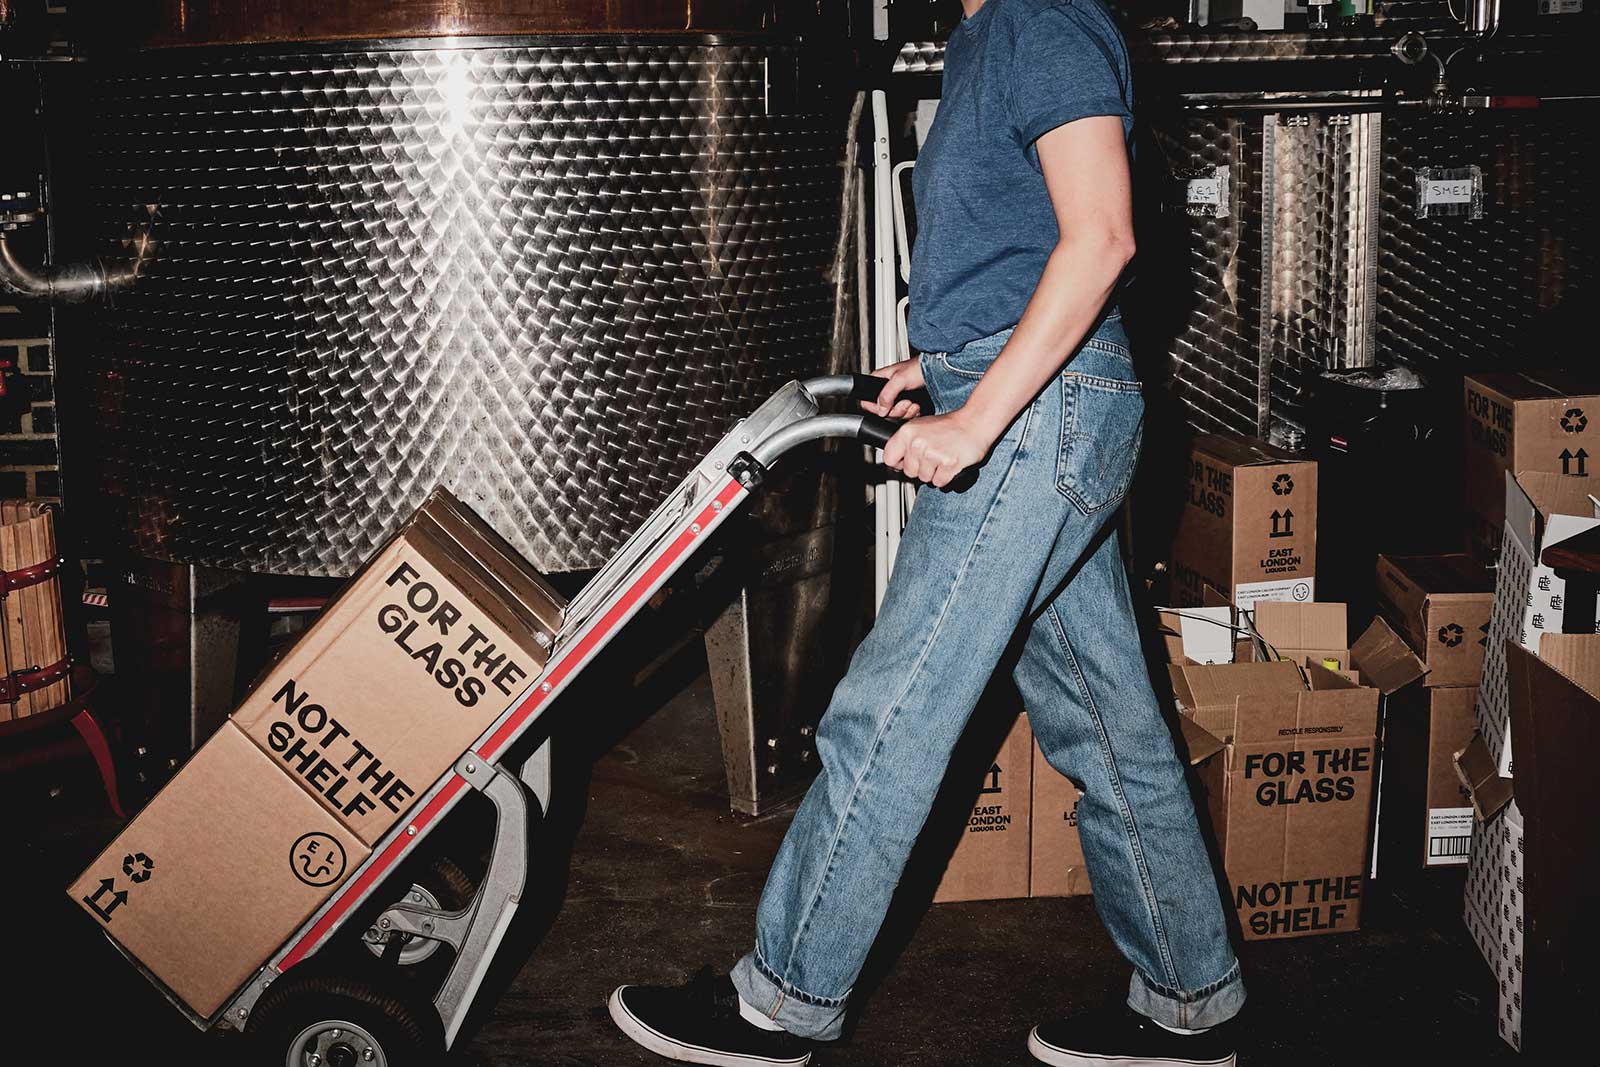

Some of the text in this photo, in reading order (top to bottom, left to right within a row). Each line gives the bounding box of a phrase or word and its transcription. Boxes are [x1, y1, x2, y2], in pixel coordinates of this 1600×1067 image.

[1187, 185, 1215, 195] ME1
[1432, 185, 1470, 196] SME1
[1468, 389, 1512, 432] FOR THE
[1206, 466, 1231, 496] THE
[1260, 556, 1301, 568] LONDON
[1269, 548, 1294, 558] EAST
[385, 561, 463, 636] FOR
[457, 623, 528, 697] THE
[378, 604, 486, 707] GLASS
[271, 678, 416, 814] NOT THE
[1278, 726, 1344, 736] RECYCLE RESPONSIBLY
[267, 721, 377, 817] SHELF
[1245, 747, 1370, 779] FOR THE
[1256, 776, 1355, 806] GLASS
[974, 806, 1002, 815] EAST
[970, 825, 994, 833] LIQUOR
[1236, 876, 1361, 909] NOT THE
[1249, 904, 1346, 935] SHELF
